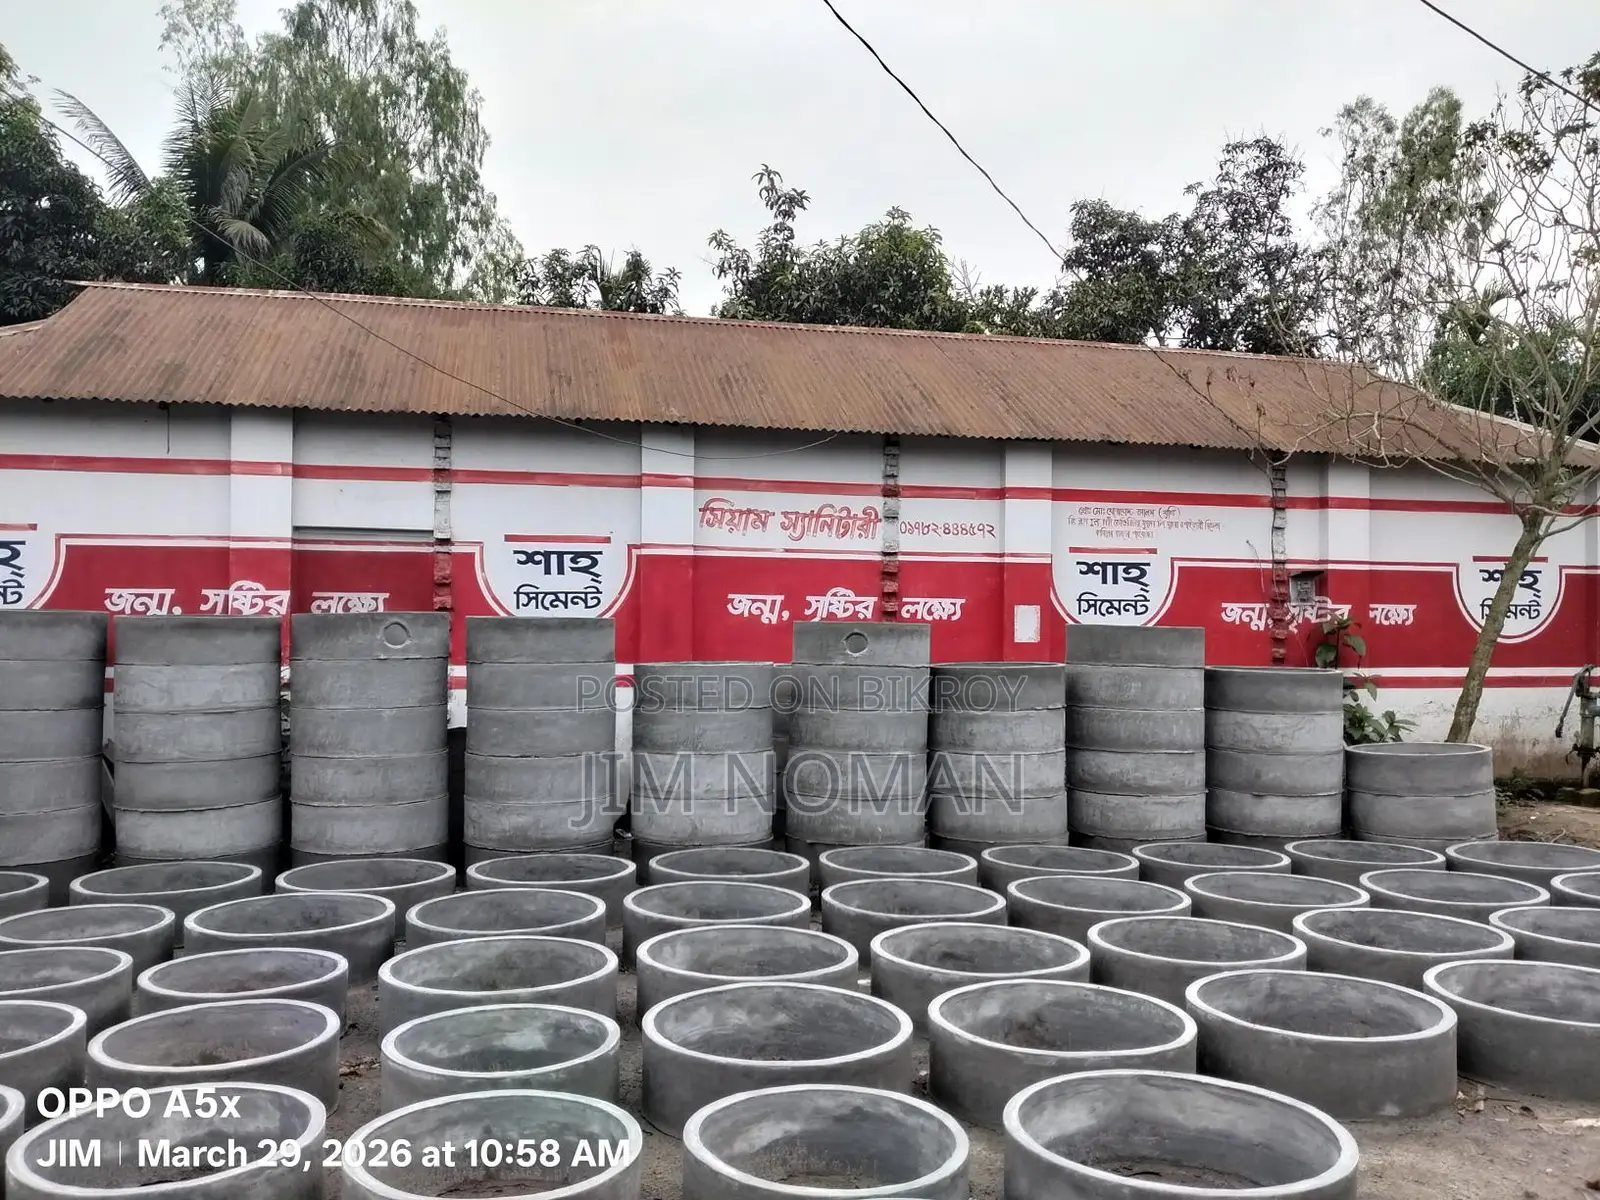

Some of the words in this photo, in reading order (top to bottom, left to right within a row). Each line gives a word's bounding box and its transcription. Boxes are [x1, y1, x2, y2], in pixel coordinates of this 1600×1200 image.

[699, 497, 775, 536] সিয়াম
[780, 503, 882, 541] স্যানিটারী
[513, 550, 603, 585] শাহ্
[1076, 561, 1151, 593] শাহ্
[514, 584, 603, 611] সিমেন্ট
[901, 597, 966, 622] লক্ষ্যে
[1077, 592, 1151, 617] সিমেন্ট
